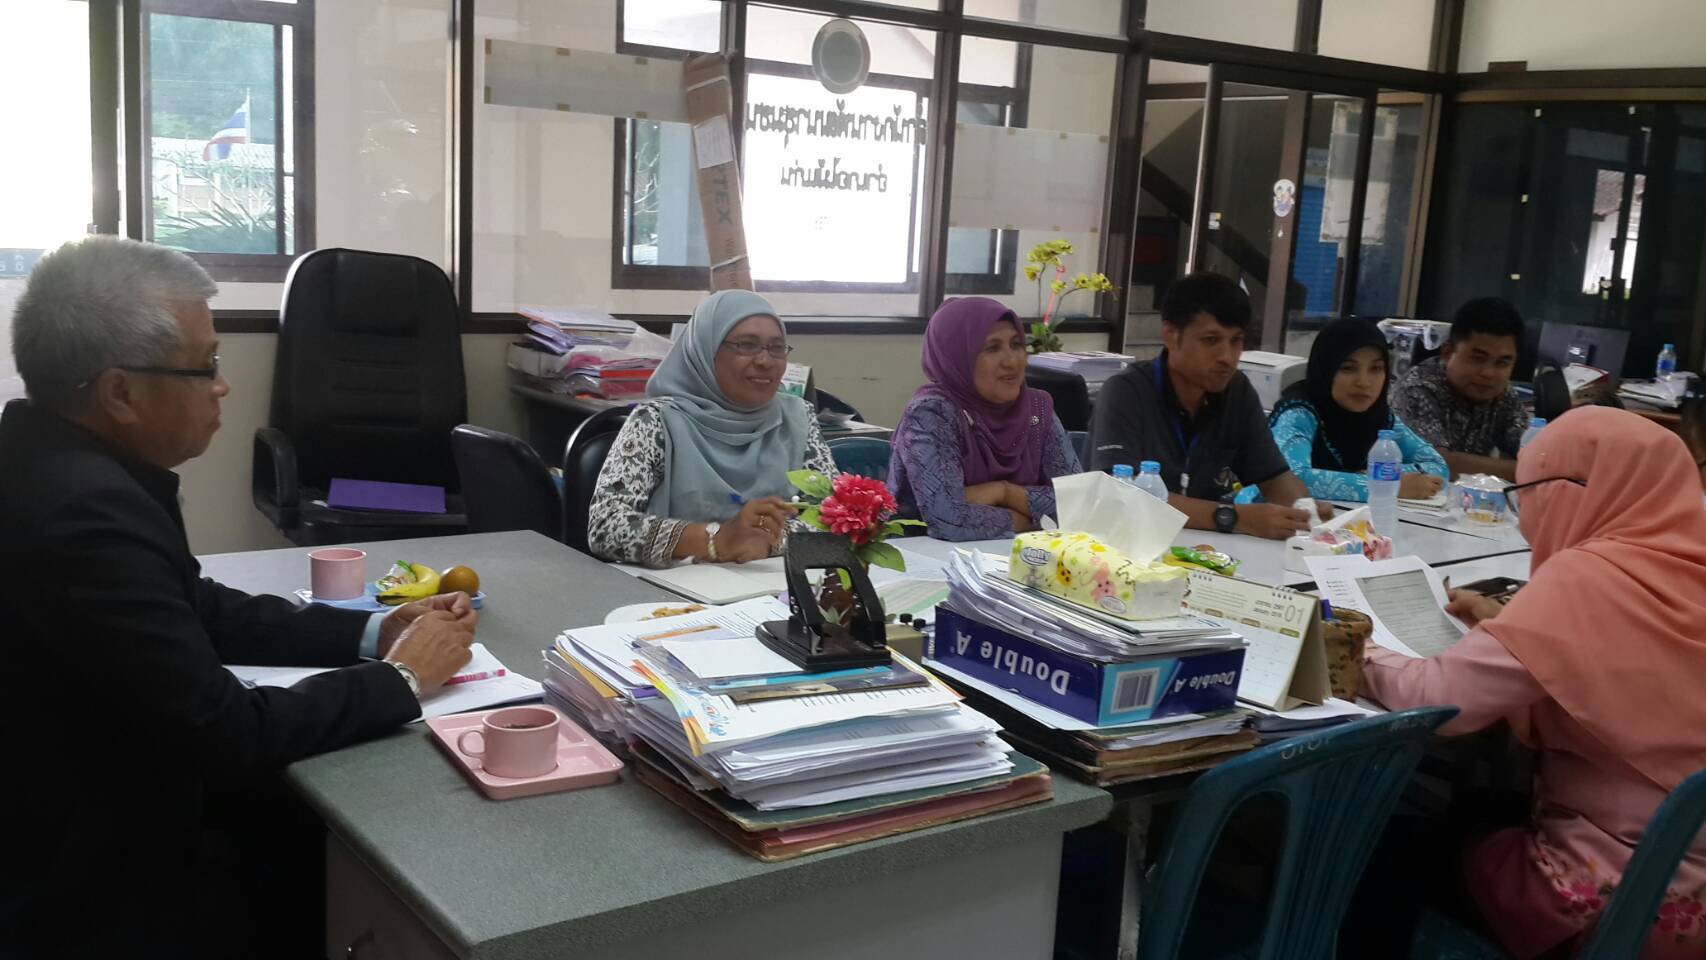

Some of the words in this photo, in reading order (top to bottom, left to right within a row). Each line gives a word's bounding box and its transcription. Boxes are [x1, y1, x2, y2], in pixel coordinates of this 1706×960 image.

[1284, 604, 1306, 624] 01
[955, 630, 973, 650] A
[980, 640, 1071, 696] Double
[1173, 678, 1187, 693] A
[1189, 670, 1236, 690] Double
